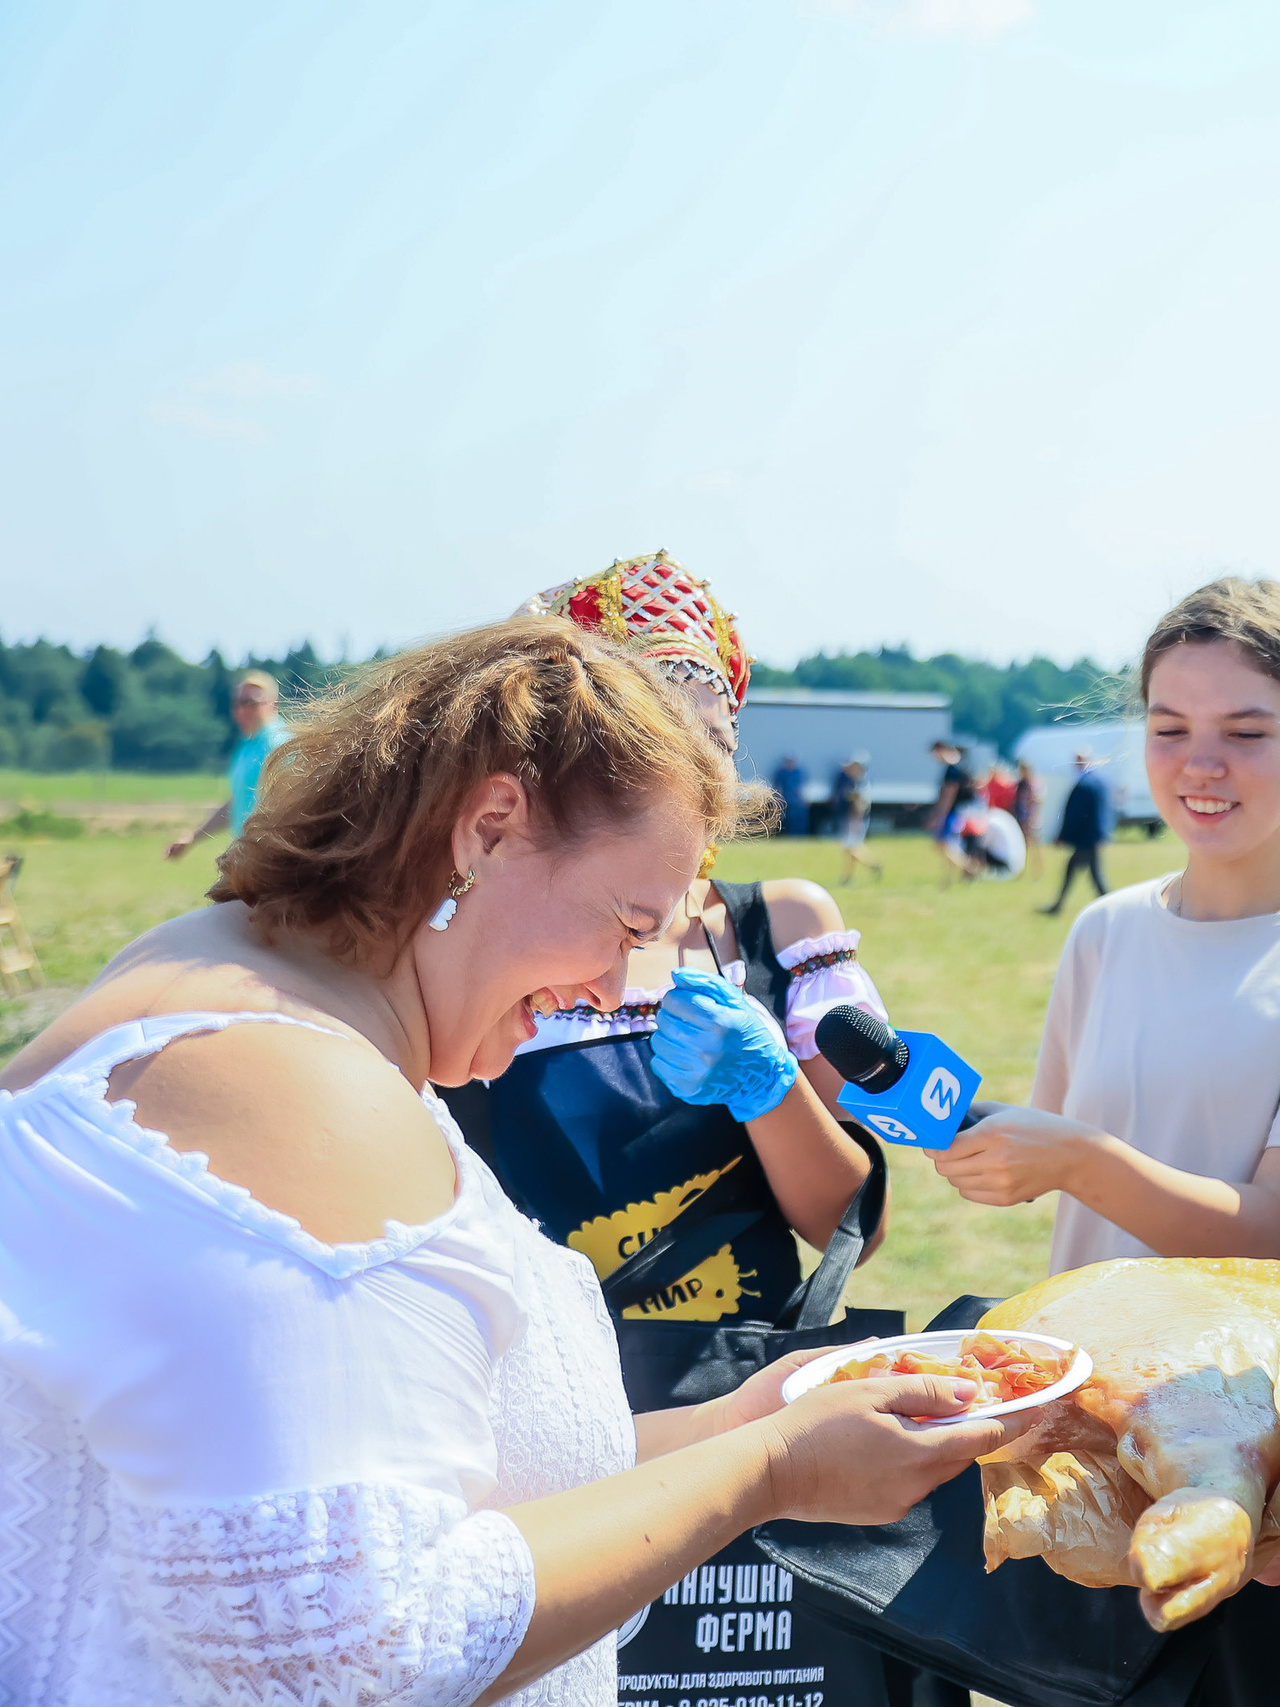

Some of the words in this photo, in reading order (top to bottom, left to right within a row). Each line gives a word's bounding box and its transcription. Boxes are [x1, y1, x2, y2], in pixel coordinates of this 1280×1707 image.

[695, 1609, 792, 1653] ФЕРМА
[617, 1673, 679, 1691] ПРОДУКТЫ
[680, 1672, 707, 1690] ДЛЯ
[708, 1670, 772, 1689] ЗДОРОВОГО
[773, 1667, 825, 1684] ПИТАНИЯ
